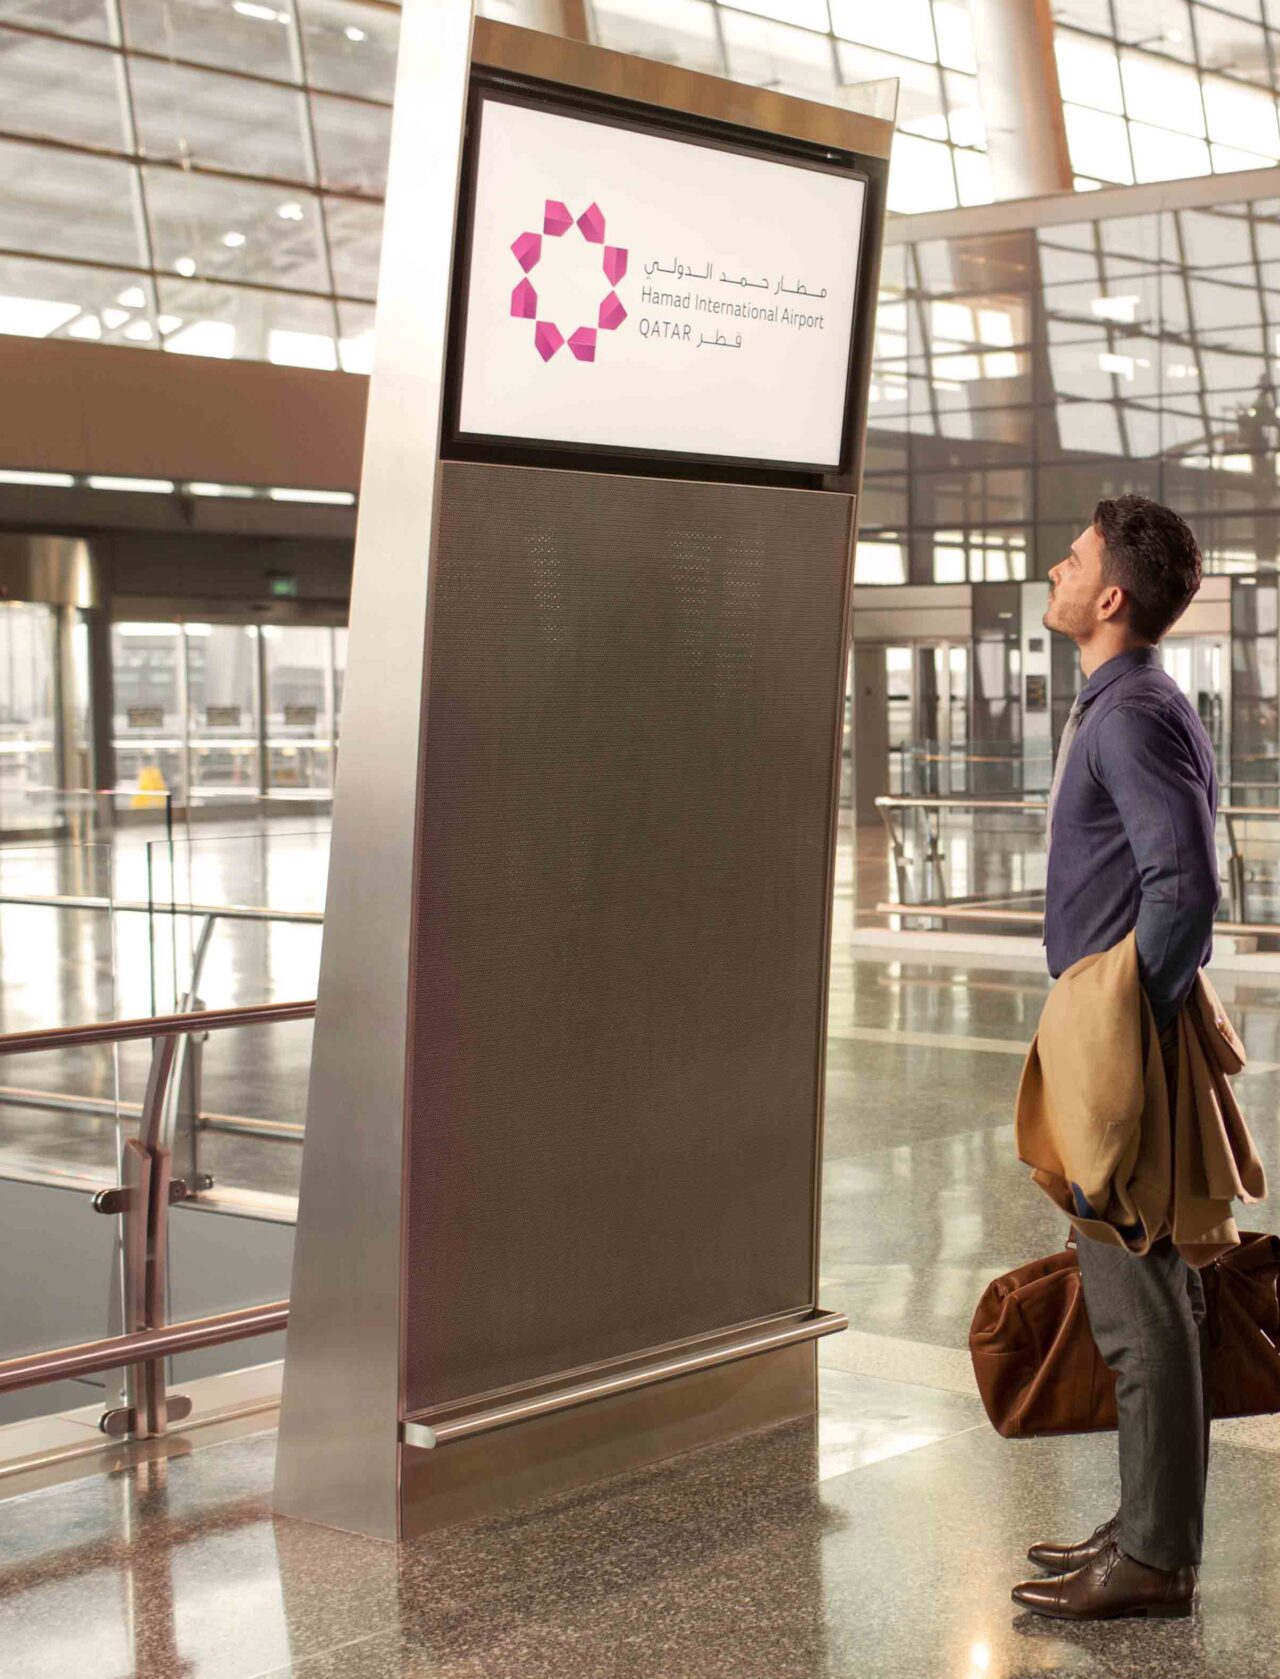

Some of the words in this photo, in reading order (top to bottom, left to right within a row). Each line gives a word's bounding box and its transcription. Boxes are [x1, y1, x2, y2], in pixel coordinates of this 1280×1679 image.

[644, 256, 713, 280] الدولي
[719, 271, 769, 289] حمد
[774, 275, 827, 298] مطار
[641, 285, 690, 309] Hamad
[695, 294, 778, 322] International
[781, 308, 825, 330] Airport
[639, 318, 692, 341] QATAR
[696, 328, 742, 348] قطر
